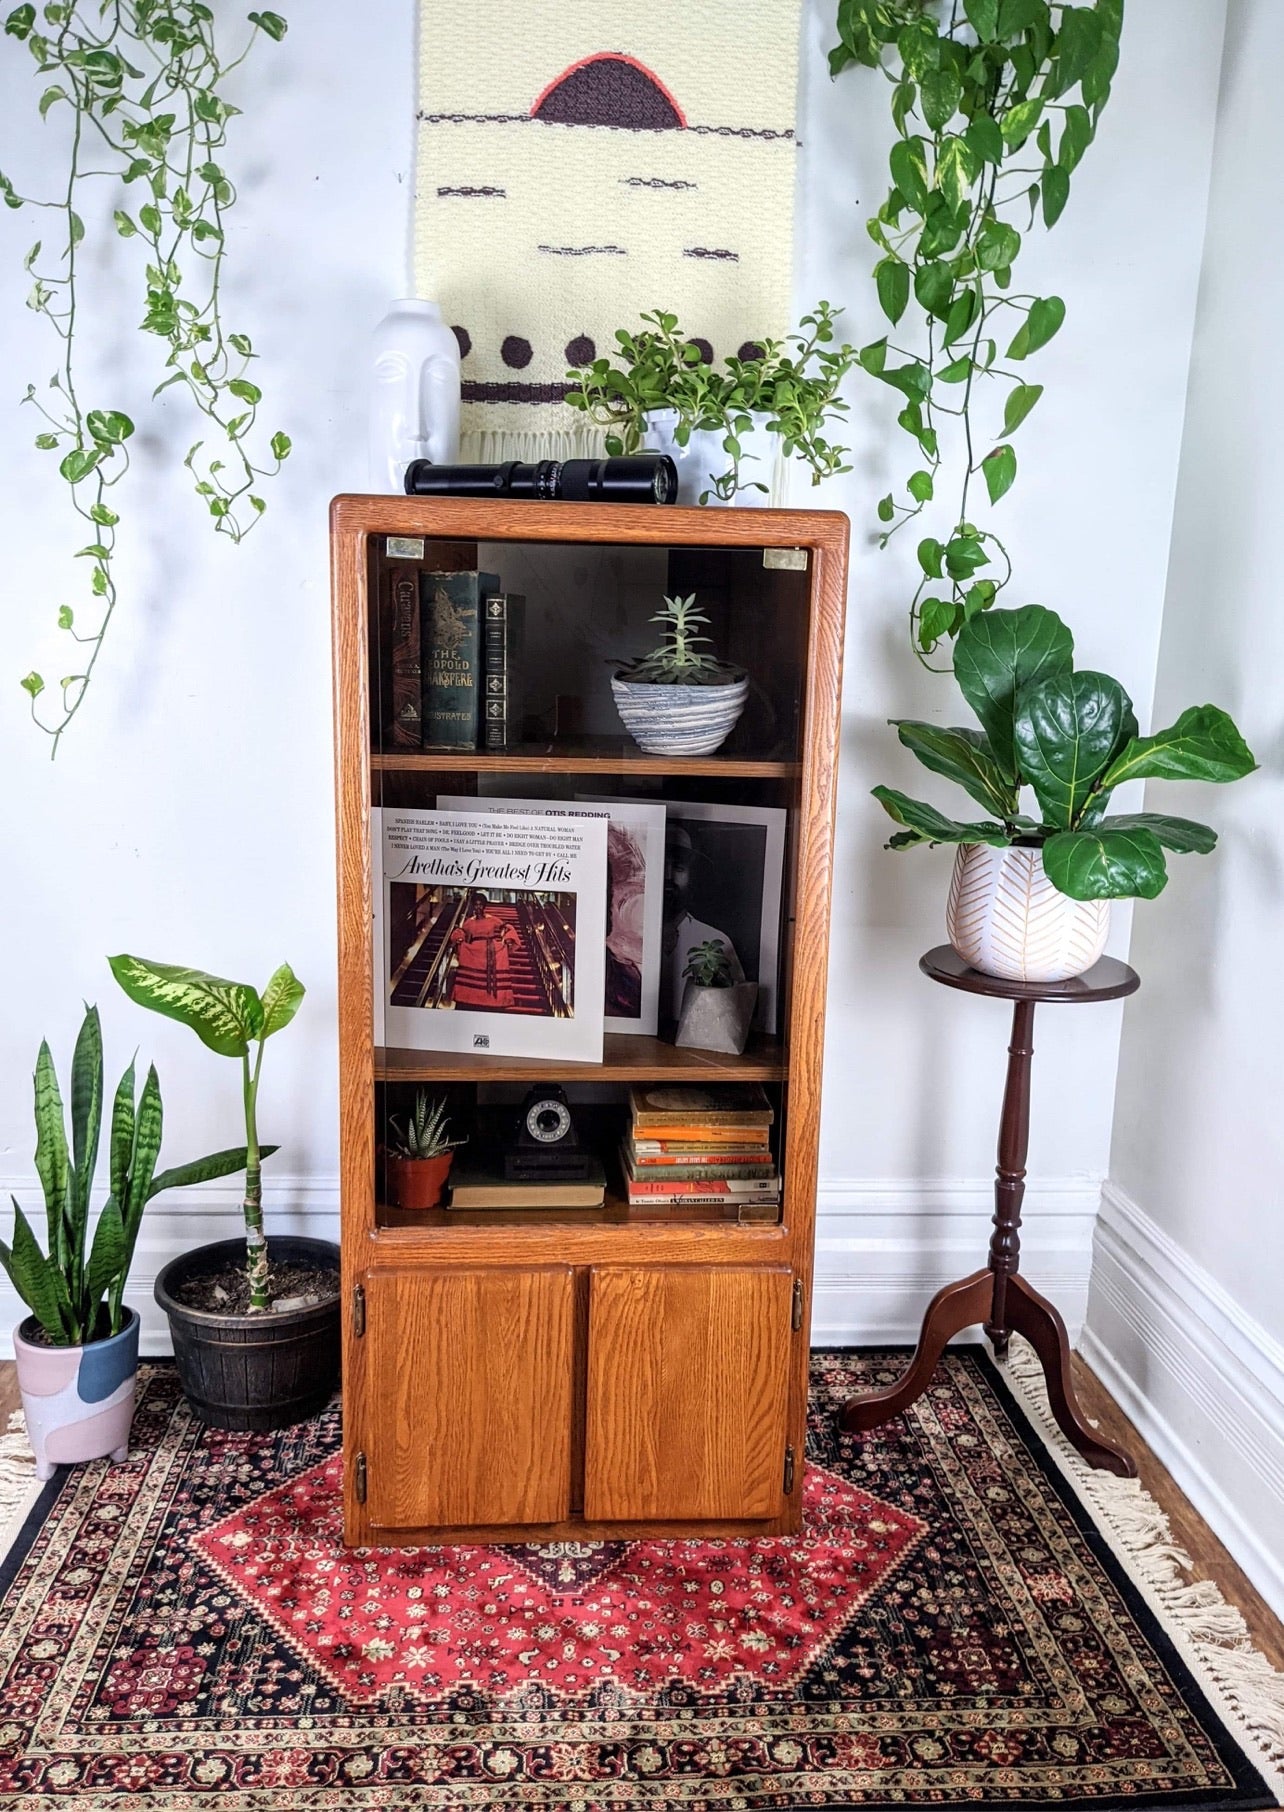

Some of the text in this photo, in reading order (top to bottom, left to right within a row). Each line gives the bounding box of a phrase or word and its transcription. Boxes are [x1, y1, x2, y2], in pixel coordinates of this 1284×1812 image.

[432, 650, 461, 660] THE
[568, 810, 610, 819] REDDING
[384, 856, 571, 888] Aretha's Greatest Hits
